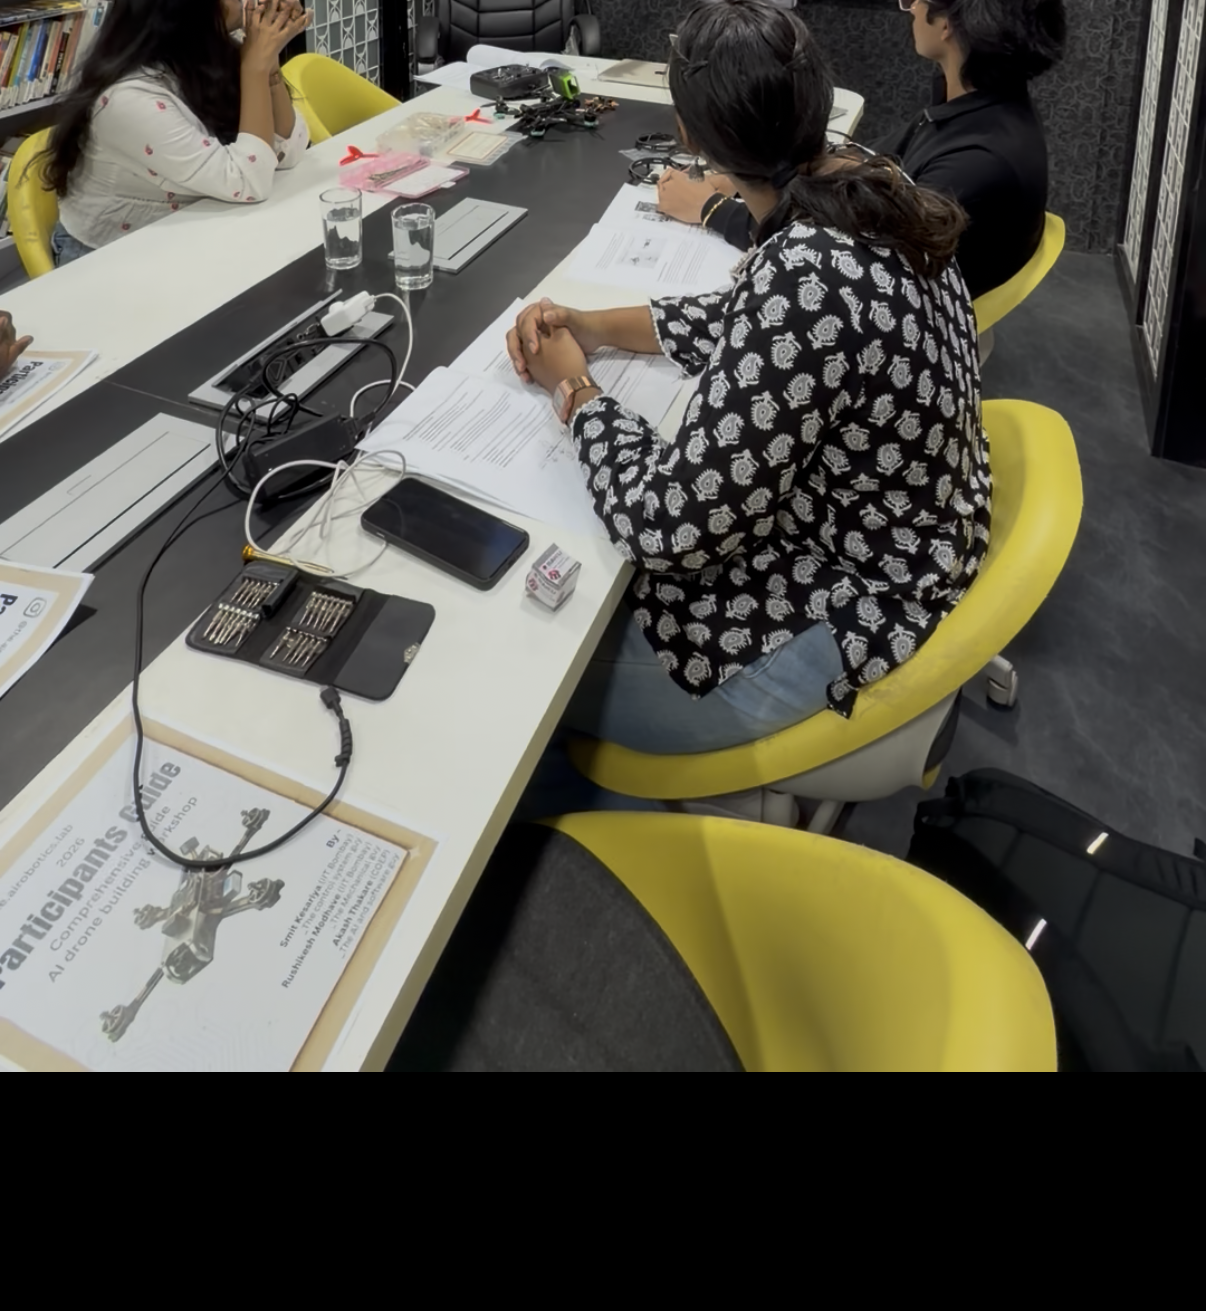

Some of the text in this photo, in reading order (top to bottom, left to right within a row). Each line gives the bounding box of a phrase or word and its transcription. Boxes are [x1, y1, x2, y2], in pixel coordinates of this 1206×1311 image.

[56, 837, 85, 868] 2026
[326, 834, 340, 848] By
[49, 806, 171, 952] Comprehensive uide
[332, 916, 352, 947] Akash
[348, 879, 373, 915] Thakare
[48, 964, 65, 983] AI
[64, 917, 103, 963] drone
[99, 857, 152, 915] building
[280, 924, 298, 948] Smit
[294, 884, 322, 924] Kesariya
[281, 937, 316, 988] Rushikesh
[312, 893, 341, 937] Modhave
